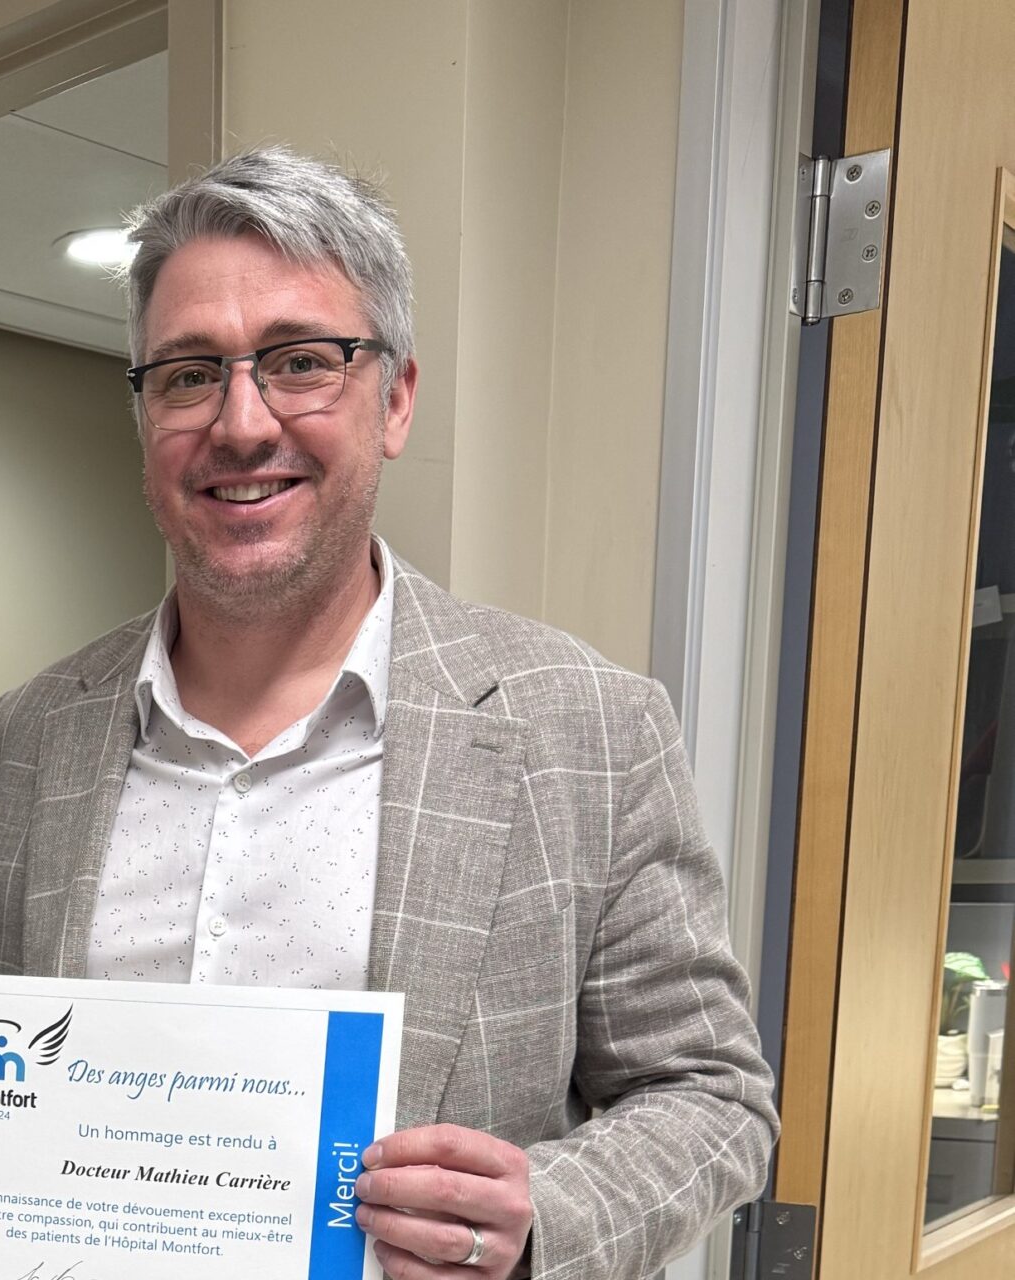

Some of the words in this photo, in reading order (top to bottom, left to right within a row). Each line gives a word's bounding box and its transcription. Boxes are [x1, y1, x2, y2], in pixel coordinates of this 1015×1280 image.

[67, 1059, 105, 1084] Des
[108, 1069, 167, 1100] anges
[167, 1071, 238, 1102] parmi
[241, 1076, 306, 1097] nous...
[78, 1123, 99, 1138] Un
[104, 1125, 184, 1147] hommage
[188, 1133, 212, 1147] est
[216, 1134, 263, 1150] rendu
[267, 1136, 277, 1150] à
[60, 1159, 131, 1181] Docteur
[133, 1165, 210, 1186] Mathieu
[215, 1171, 291, 1191] Carrière
[327, 1142, 359, 1228] Merci!
[66, 1197, 83, 1210] de
[86, 1201, 119, 1213] votre
[122, 1202, 205, 1220] dévouement
[208, 1211, 292, 1226] exceptionnel
[6, 1227, 27, 1239] des
[31, 1230, 81, 1244] patients
[84, 1233, 101, 1246] de
[104, 1234, 158, 1252] l'Hôpital
[161, 1240, 224, 1256] Montfort.
[17, 1212, 95, 1229] compassion,
[98, 1218, 119, 1232] qui
[122, 1221, 198, 1237] contribuent
[201, 1228, 218, 1238] au
[221, 1229, 293, 1243] mieux-être
